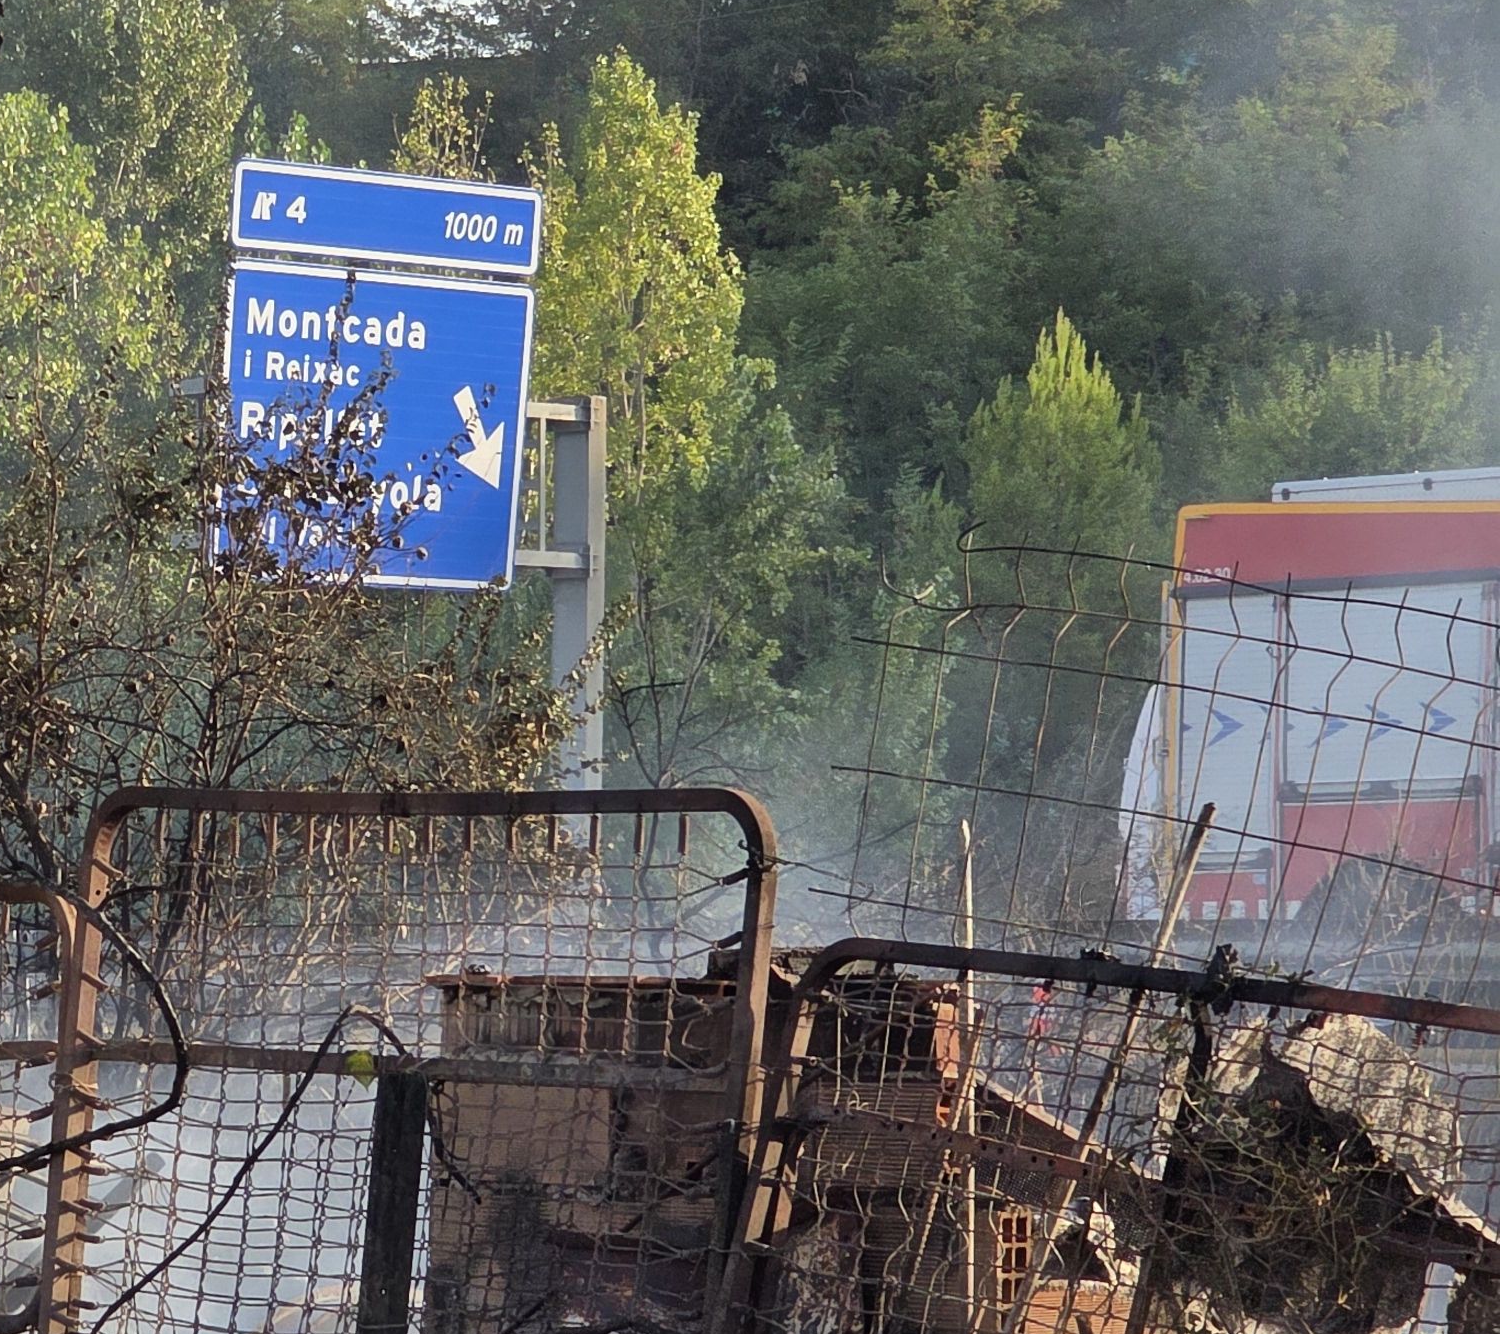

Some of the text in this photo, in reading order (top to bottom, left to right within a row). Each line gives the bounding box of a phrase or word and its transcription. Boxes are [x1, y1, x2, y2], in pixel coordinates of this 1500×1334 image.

[285, 195, 524, 246] 4 1000 m
[246, 297, 427, 350] Montcada
[243, 350, 360, 387] i Reixac
[240, 401, 385, 451] Riplet
